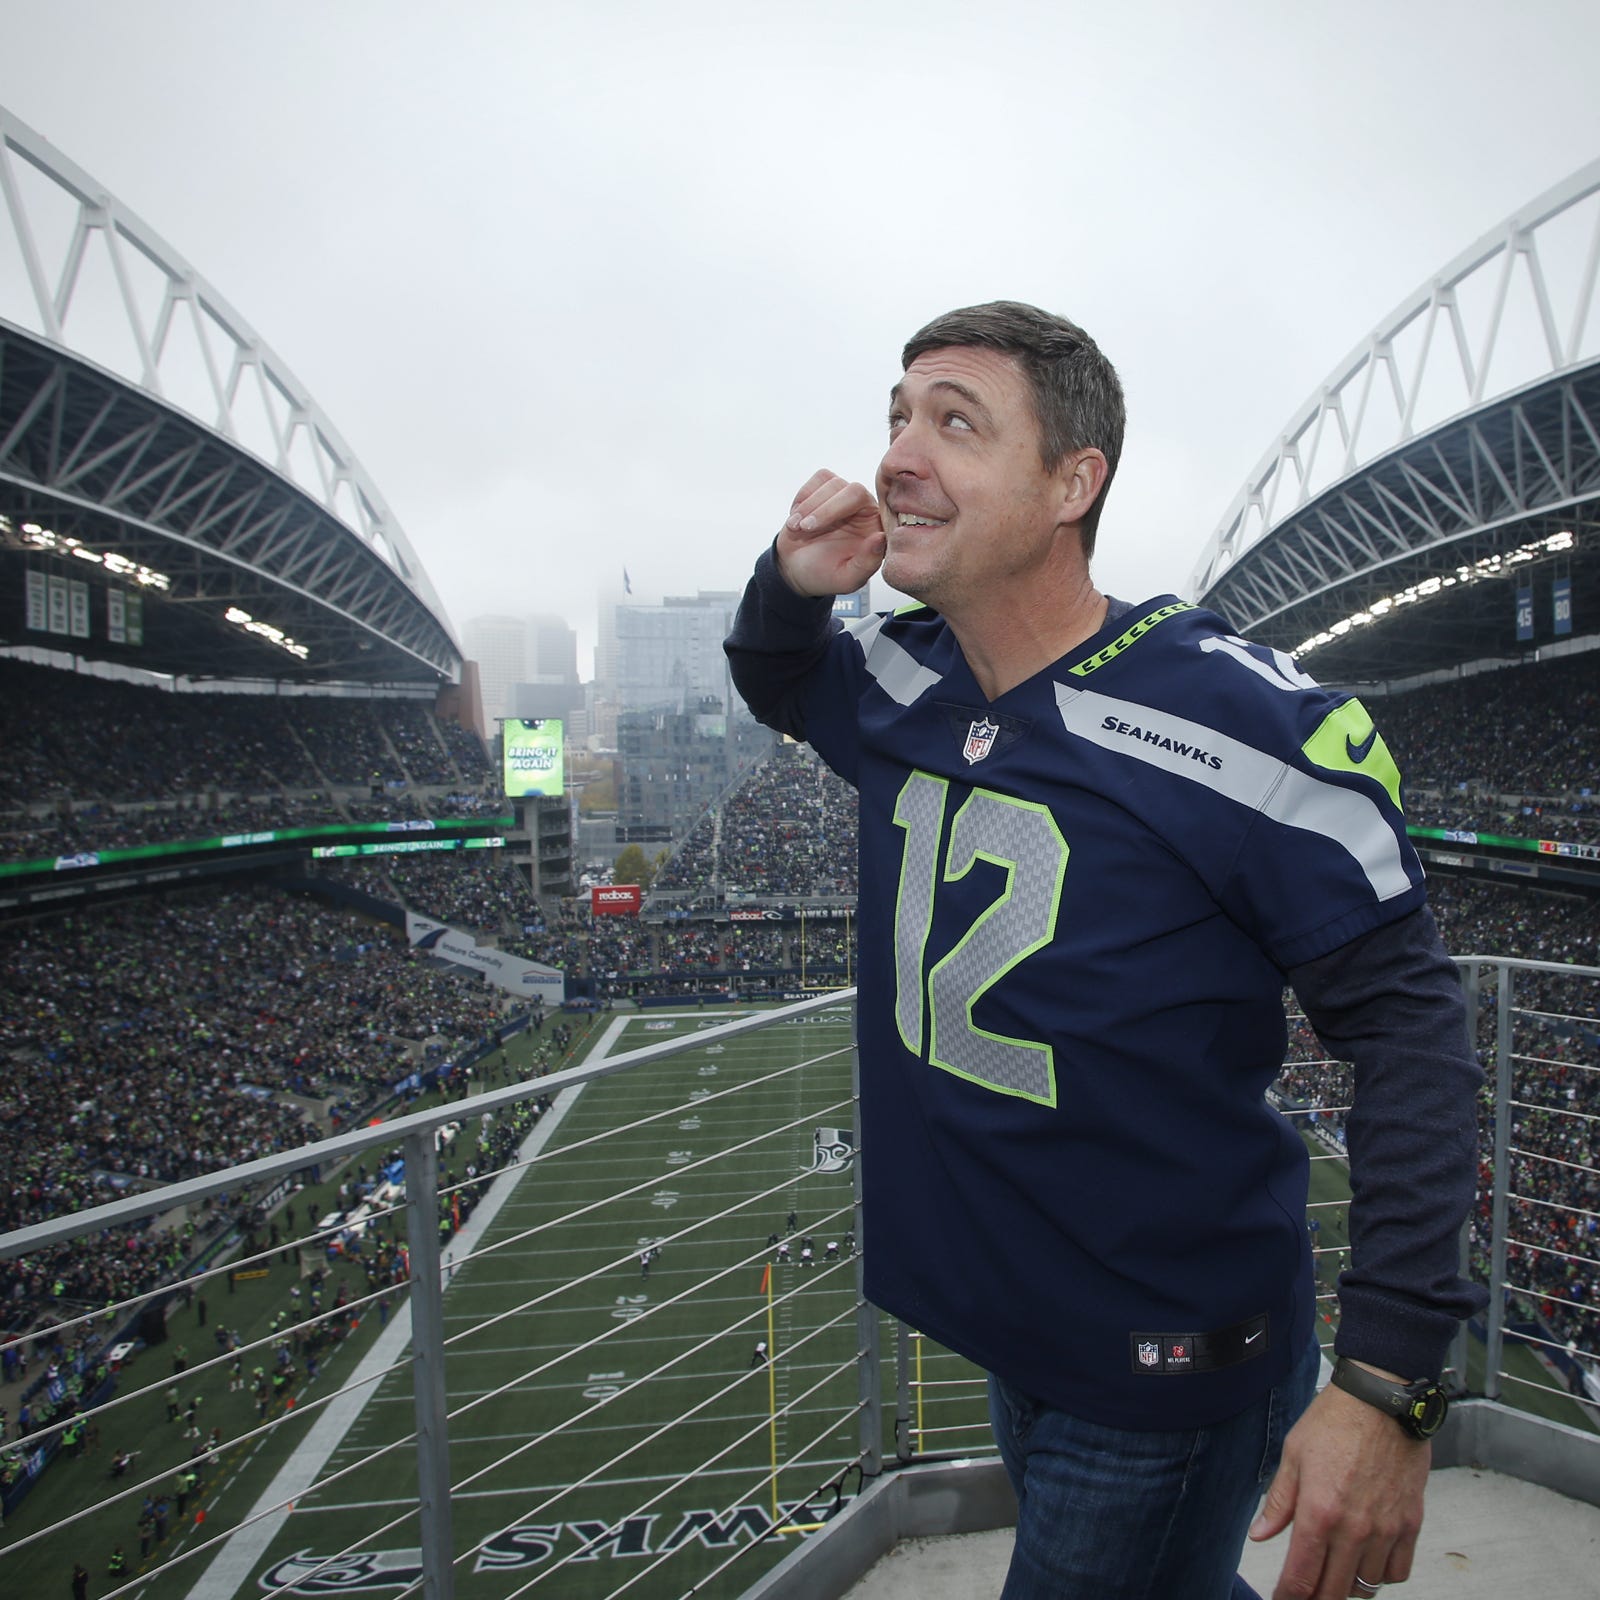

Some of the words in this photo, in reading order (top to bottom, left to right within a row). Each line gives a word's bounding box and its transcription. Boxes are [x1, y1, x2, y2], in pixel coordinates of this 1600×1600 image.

[1517, 607, 1533, 627] 45
[968, 739, 988, 757] NFL
[1101, 716, 1223, 770] SEAHAWKS
[508, 747, 543, 757] BRING
[547, 747, 557, 757] IT
[513, 758, 552, 769] AGAIN
[415, 841, 444, 850] AGAIN
[794, 909, 828, 918] HAWKS
[831, 909, 856, 918] NEST
[892, 768, 1070, 1110] 12
[1140, 1352, 1157, 1362] NFL
[582, 1371, 626, 1399] 10
